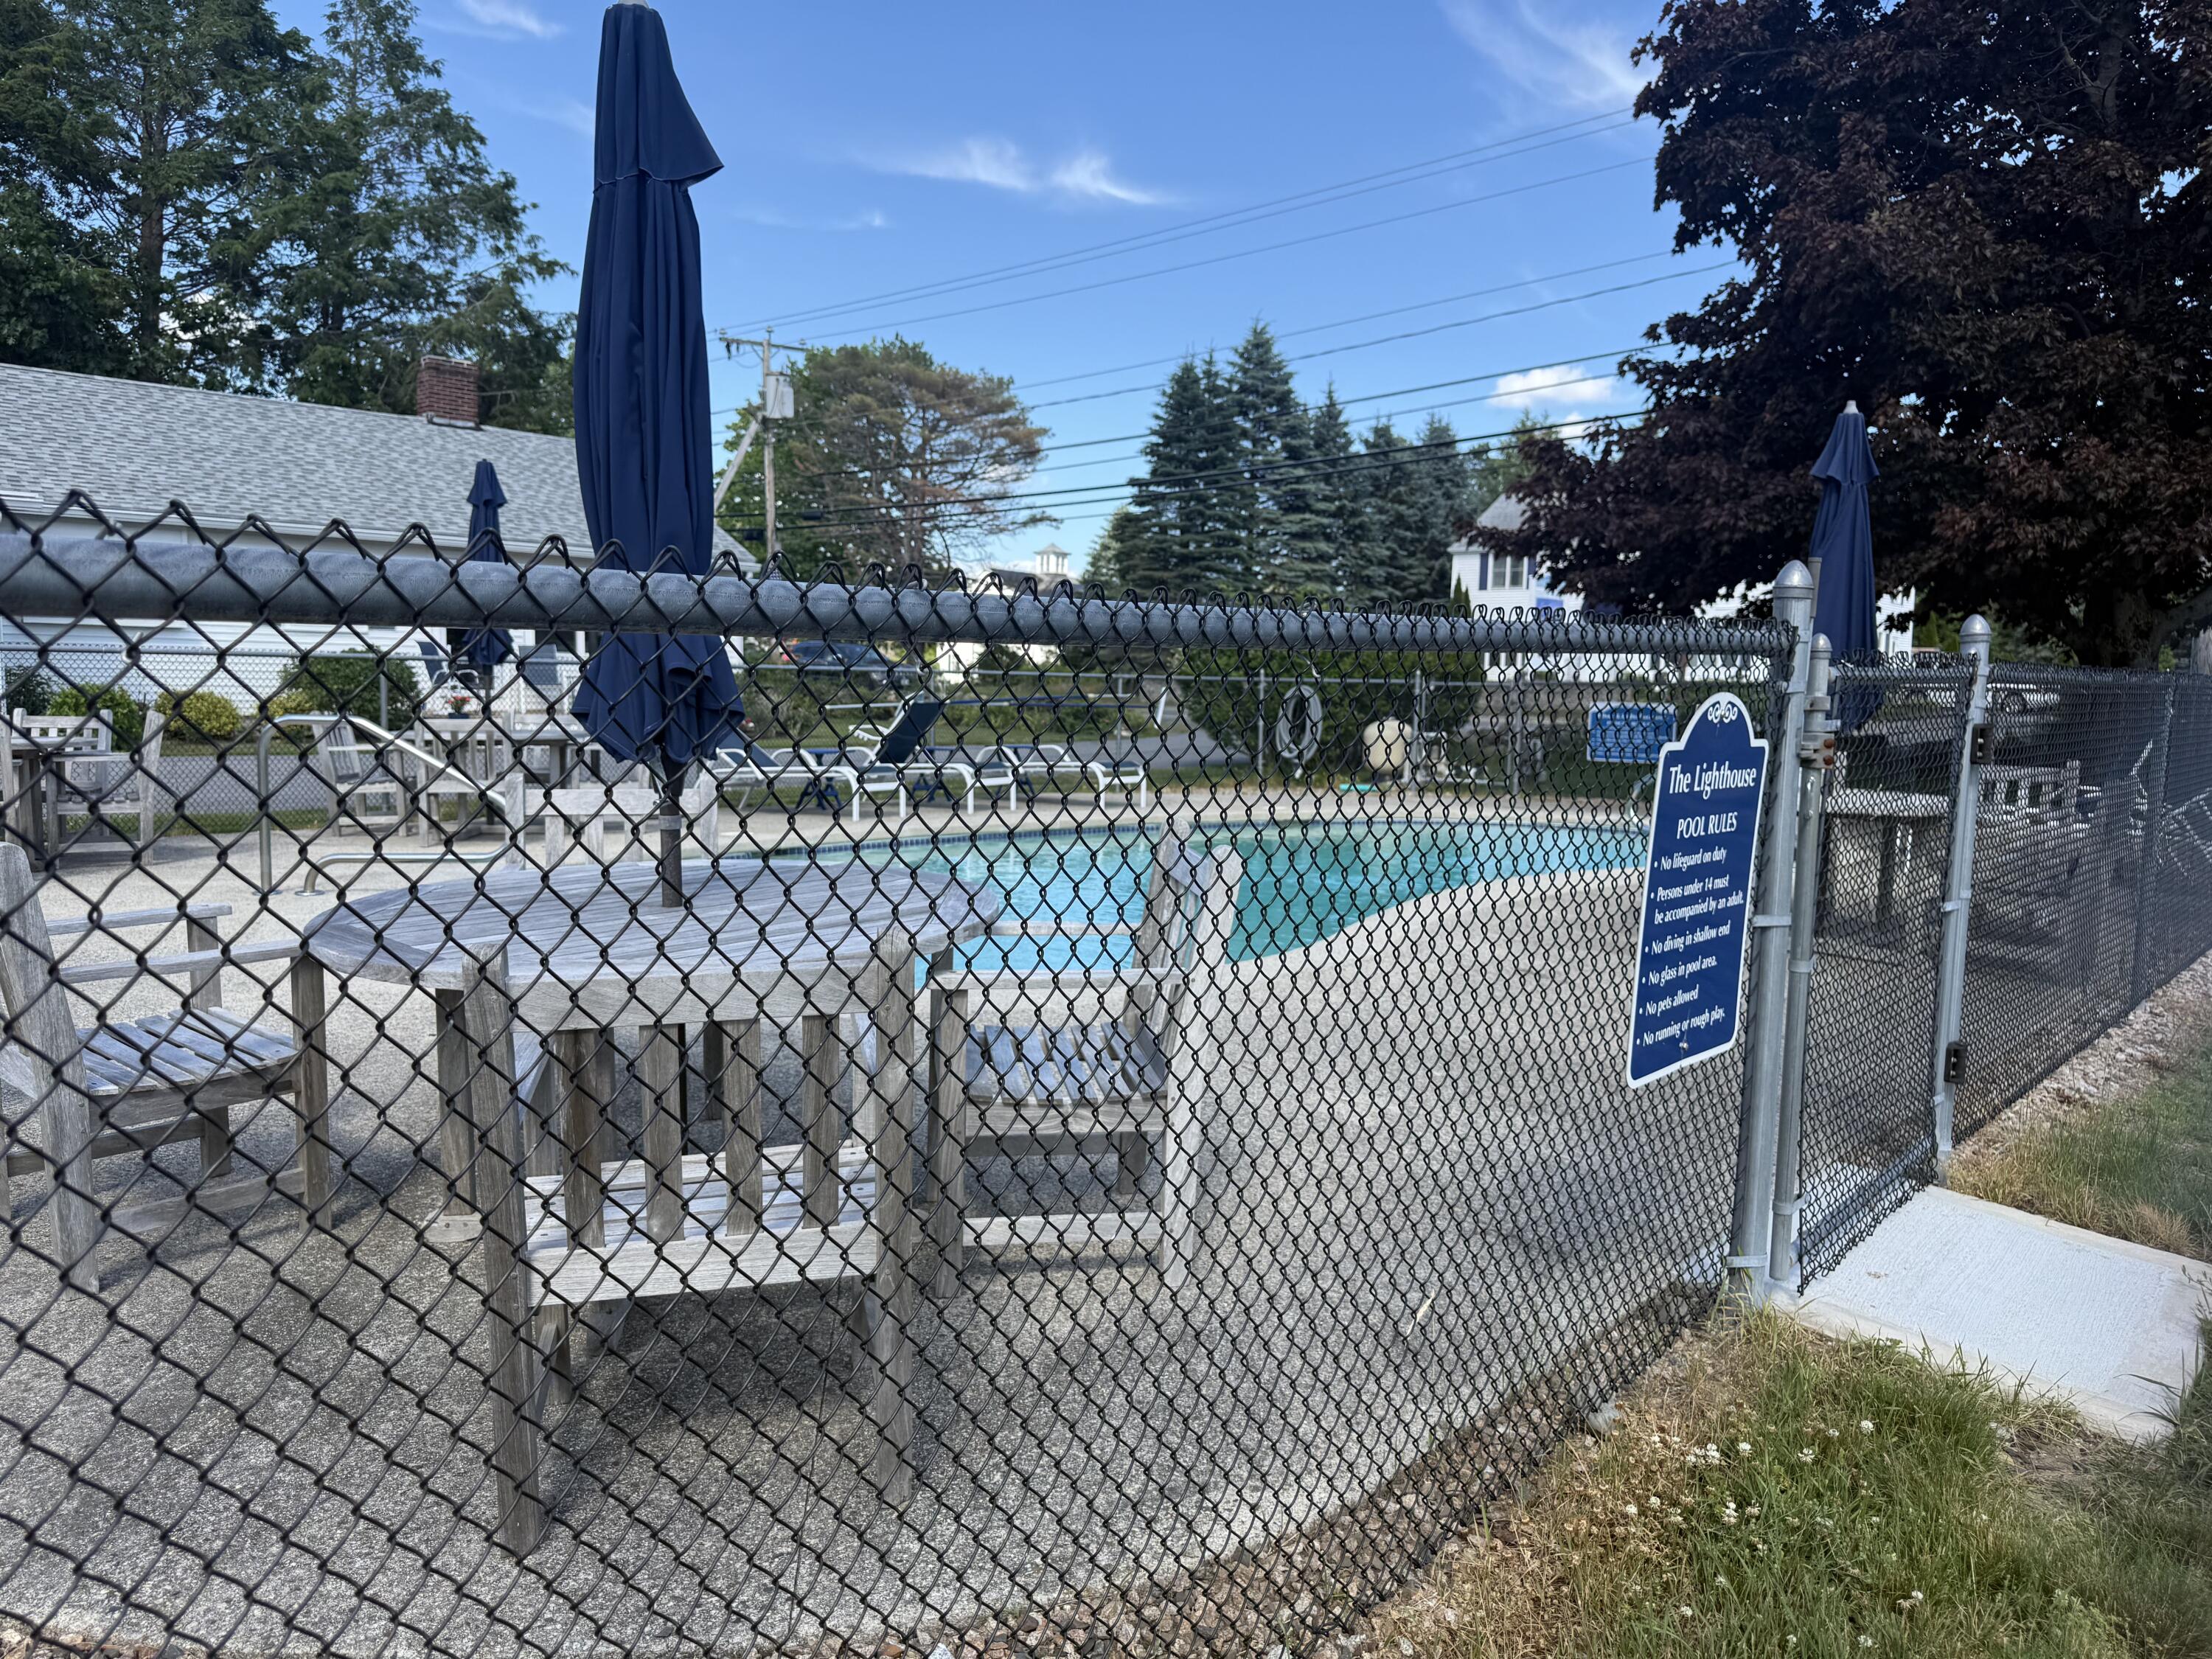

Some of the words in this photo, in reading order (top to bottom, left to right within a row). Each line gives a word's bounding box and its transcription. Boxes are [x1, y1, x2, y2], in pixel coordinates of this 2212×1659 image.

[1669, 765, 1691, 794] The
[1694, 761, 1757, 799] Lighthouse
[1677, 815, 1705, 839] POOL
[1708, 812, 1737, 835] RULES
[1660, 855, 1672, 871] No
[1673, 849, 1702, 871] lifeguard
[1703, 853, 1711, 863] on
[1712, 846, 1727, 863] duty
[1658, 886, 1683, 902] Persons
[1684, 880, 1703, 892] under
[1705, 877, 1713, 891] 14
[1714, 874, 1729, 888] must
[1655, 909, 1663, 925] be
[1665, 897, 1708, 922] accompanied
[1709, 896, 1717, 914] by
[1718, 898, 1726, 908] an
[1727, 890, 1744, 907] adult.
[1652, 939, 1663, 955] No
[1664, 933, 1685, 952] diving
[1686, 931, 1692, 945] in
[1693, 925, 1717, 944] shallow
[1719, 920, 1731, 936] end
[1649, 971, 1659, 986] No
[1660, 964, 1677, 987] glass
[1678, 962, 1685, 976] in
[1686, 956, 1701, 978] pool
[1702, 956, 1717, 970] area.
[1646, 1001, 1657, 1016] No
[1658, 995, 1672, 1017] pets
[1673, 984, 1699, 1006] allowed
[1643, 1032, 1655, 1047] No
[1655, 1022, 1681, 1042] running
[1682, 1021, 1688, 1032] or
[1690, 1009, 1710, 1029] rough
[1711, 1005, 1725, 1026] play.
